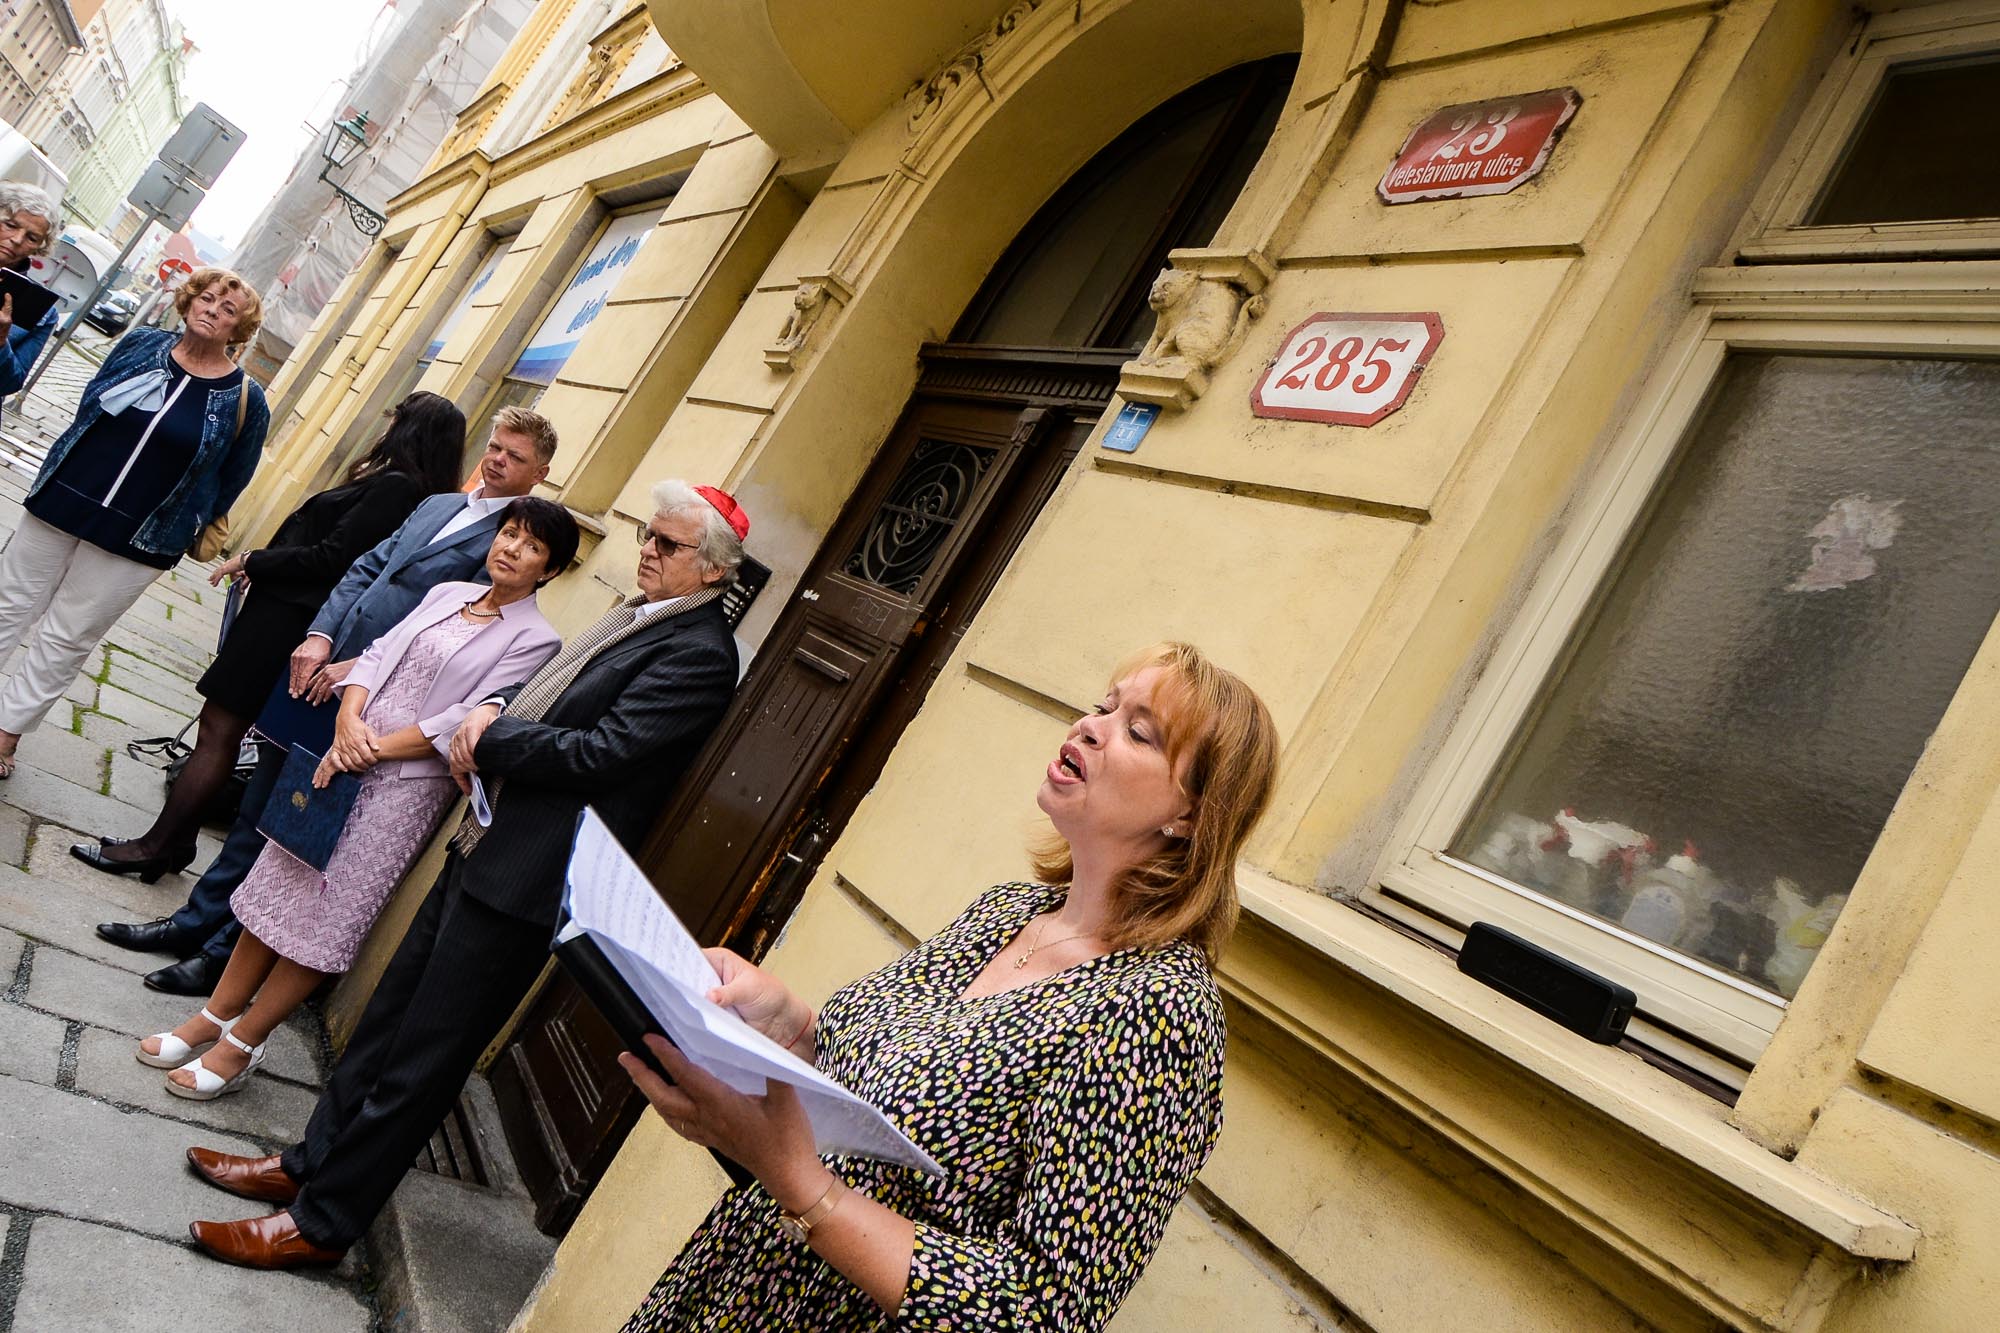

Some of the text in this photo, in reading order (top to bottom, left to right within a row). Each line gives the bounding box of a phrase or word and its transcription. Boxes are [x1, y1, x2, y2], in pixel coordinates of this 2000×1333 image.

[1430, 104, 1522, 161] 23
[1485, 153, 1524, 178] ulice
[1274, 336, 1411, 394] 285
